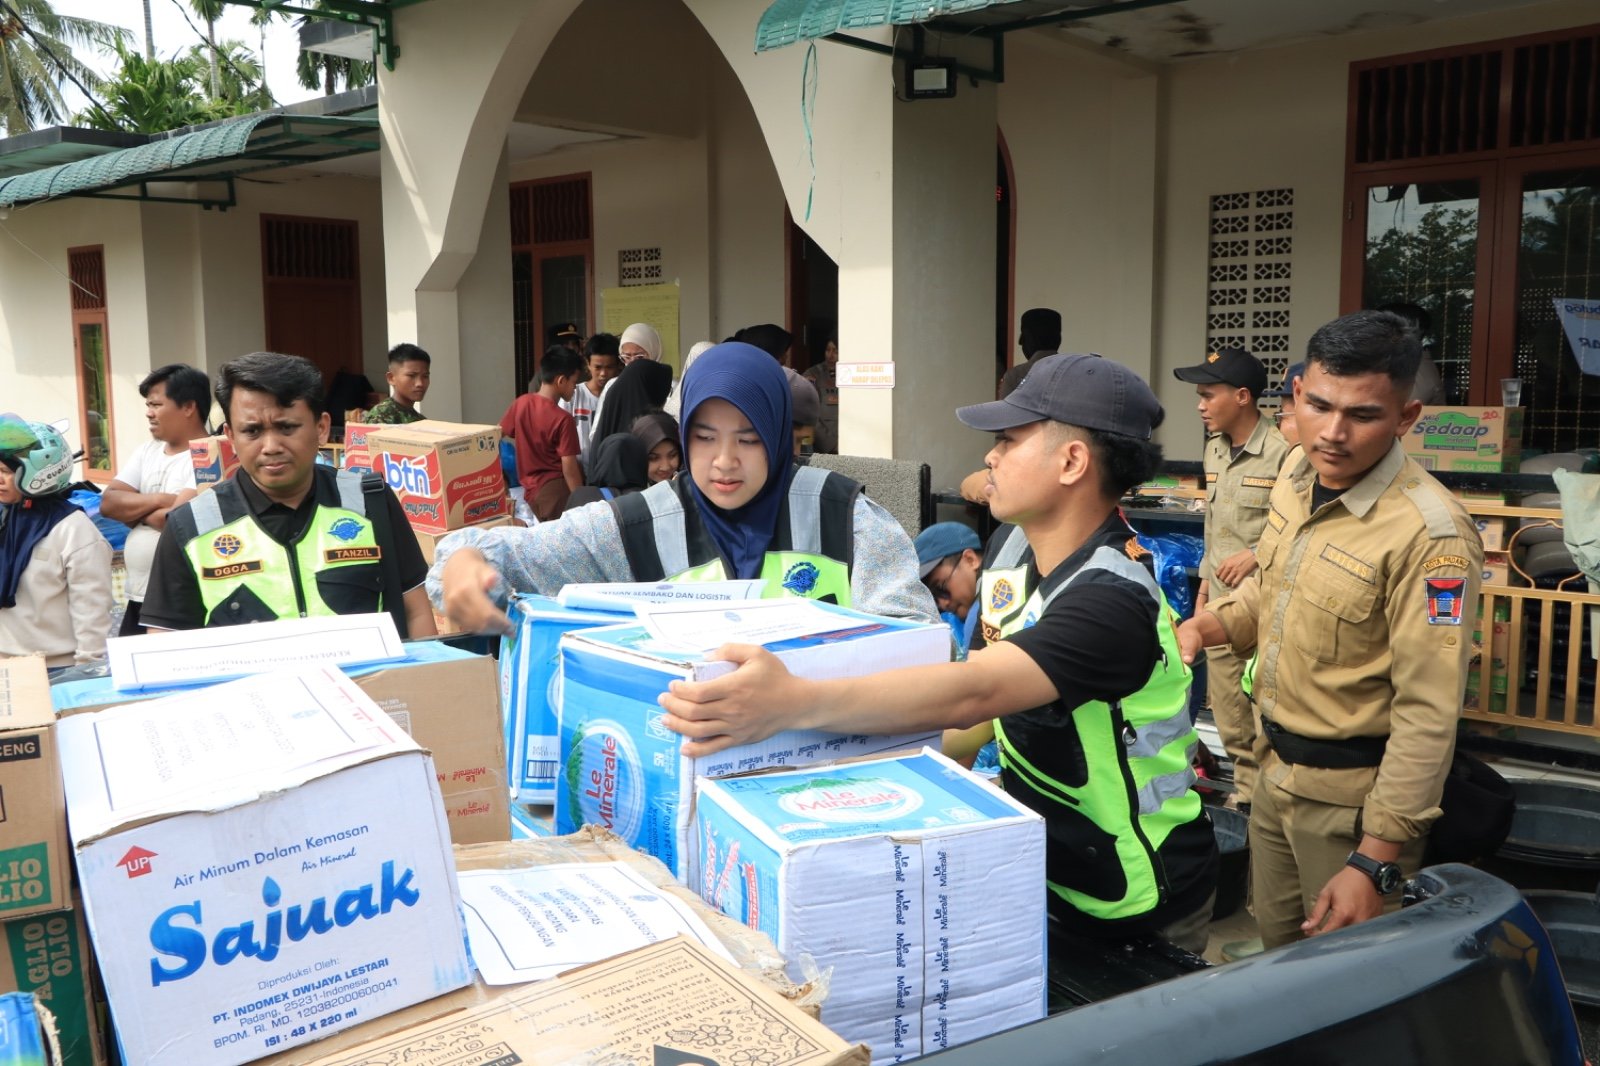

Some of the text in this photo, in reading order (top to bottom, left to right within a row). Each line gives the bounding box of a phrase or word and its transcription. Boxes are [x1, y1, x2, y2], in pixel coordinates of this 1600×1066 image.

[1413, 422, 1488, 438] Sedaap
[383, 452, 431, 498] btn
[335, 549, 372, 558] TANZIL
[1327, 550, 1369, 577] SATGAS
[1425, 556, 1468, 569] KOTA PADANG
[214, 566, 249, 577] DGCA
[586, 770, 602, 799] Le
[596, 736, 616, 830] Minerale
[798, 791, 903, 811] Minerale
[823, 790, 855, 800] Le
[127, 857, 149, 872] UP
[174, 825, 369, 889] Air Minum Dalam Kemasan
[894, 845, 905, 882] Minerale
[901, 856, 910, 867] Le
[933, 866, 941, 877] Le
[938, 851, 947, 887] Minerale
[896, 890, 906, 925] Minerale
[902, 900, 911, 911] Le
[933, 908, 941, 920] Le
[938, 894, 948, 930] Minerale
[150, 860, 420, 987] Sajuak
[47, 917, 72, 977] OLIO
[896, 933, 906, 968] Minerale
[903, 943, 911, 953] Le
[935, 951, 942, 962] Le
[939, 937, 949, 972] Minerale
[258, 968, 312, 990] Diproduksi
[658, 963, 694, 978] Dupak
[213, 958, 389, 1024] PT. INDOMEX DWIJAYA LESTARI
[604, 978, 655, 998] Surabaya
[679, 977, 711, 991] Pasar
[896, 976, 905, 1009] Minerale
[903, 986, 912, 996] Le
[240, 978, 369, 1027] Padang, 25231-Indonesia
[641, 990, 674, 1004] Atum
[696, 996, 737, 1013] Depot
[933, 993, 942, 1001] Le
[939, 979, 949, 1010] Minerale
[580, 1004, 639, 1026] Surabaya
[674, 1012, 694, 1021] Bu
[265, 1036, 281, 1047] ISI
[291, 1026, 305, 1037] 48
[320, 1014, 342, 1027] 220
[345, 1008, 357, 1018] ml
[636, 1020, 671, 1036] Rudy
[895, 1015, 904, 1048] Minerale
[901, 1024, 909, 1034] Le
[933, 1031, 941, 1042] Le
